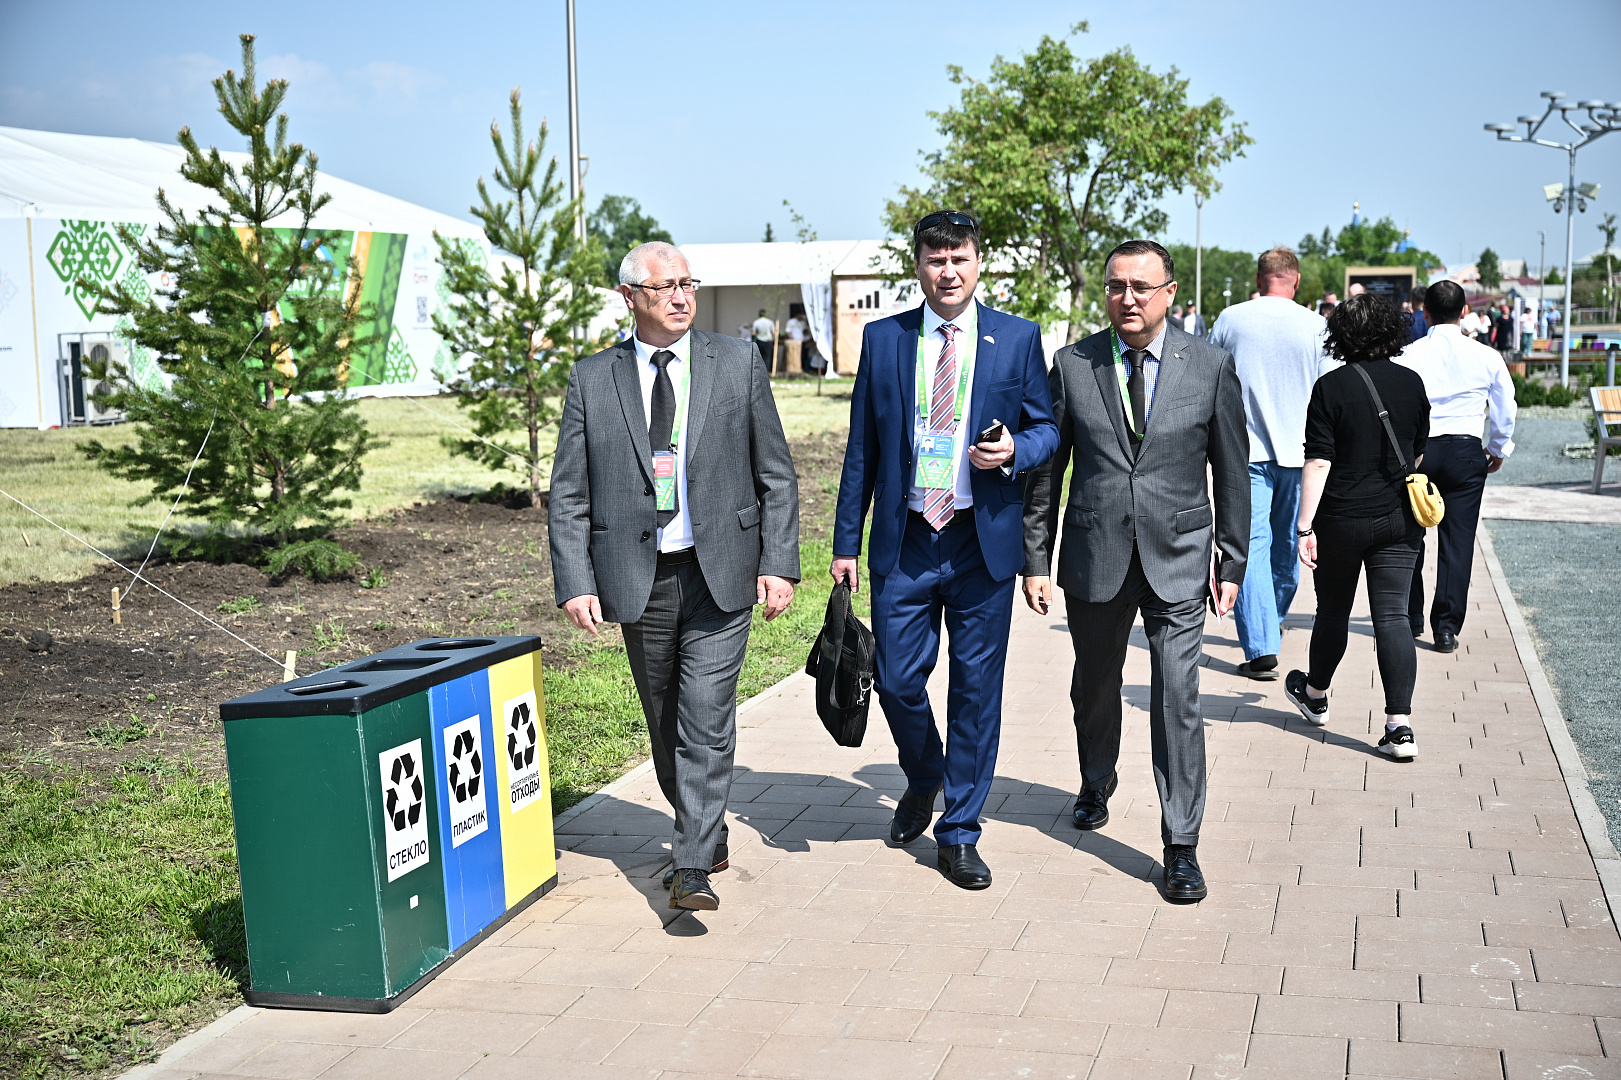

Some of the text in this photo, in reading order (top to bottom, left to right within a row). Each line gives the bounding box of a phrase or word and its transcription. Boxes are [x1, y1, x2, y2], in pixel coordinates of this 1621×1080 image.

[511, 777, 540, 803] ОТХОДЫ
[453, 810, 486, 837] ПЛАСТИК
[390, 840, 427, 870] СТЕКЛО
